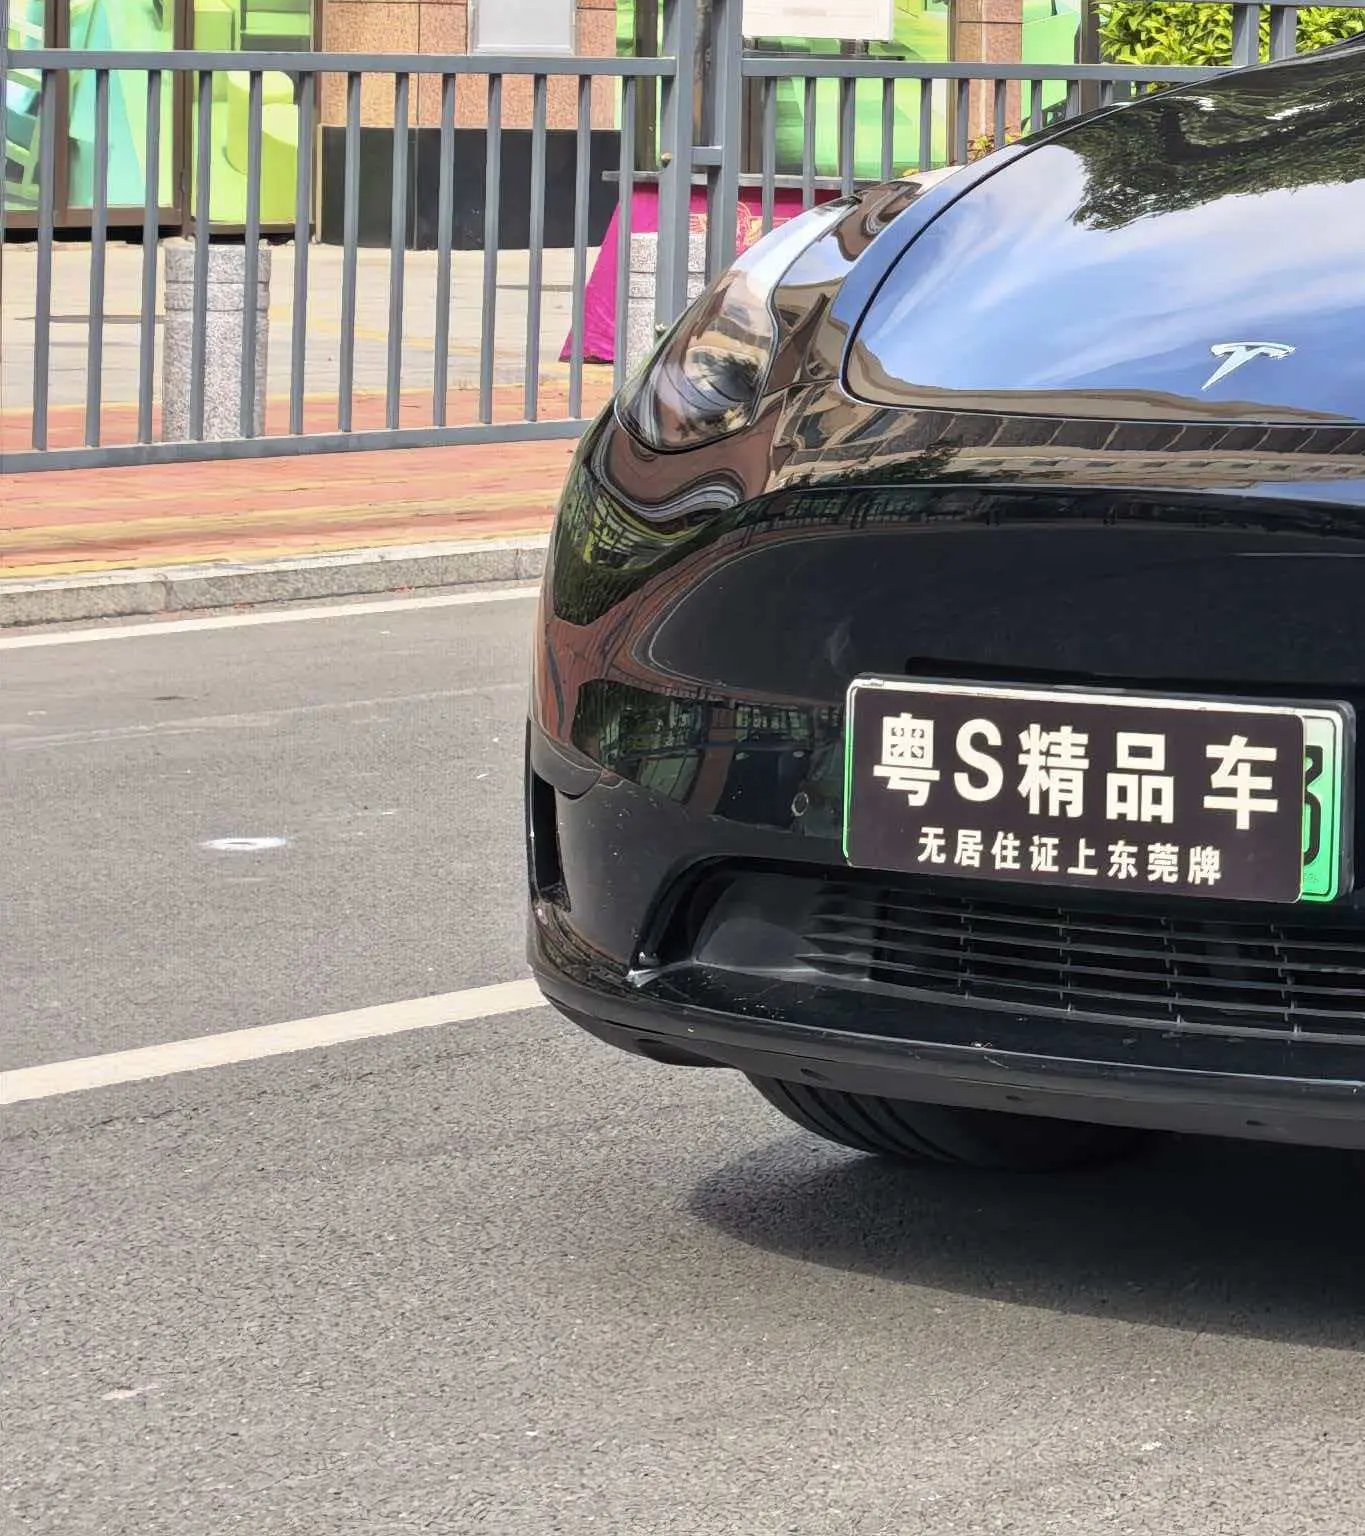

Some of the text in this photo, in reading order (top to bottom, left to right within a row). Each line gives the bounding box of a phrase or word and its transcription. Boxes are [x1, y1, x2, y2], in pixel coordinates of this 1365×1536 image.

[873, 712, 1280, 831] 粤S精品车
[917, 825, 1223, 887] 无居住证上东莞牌
